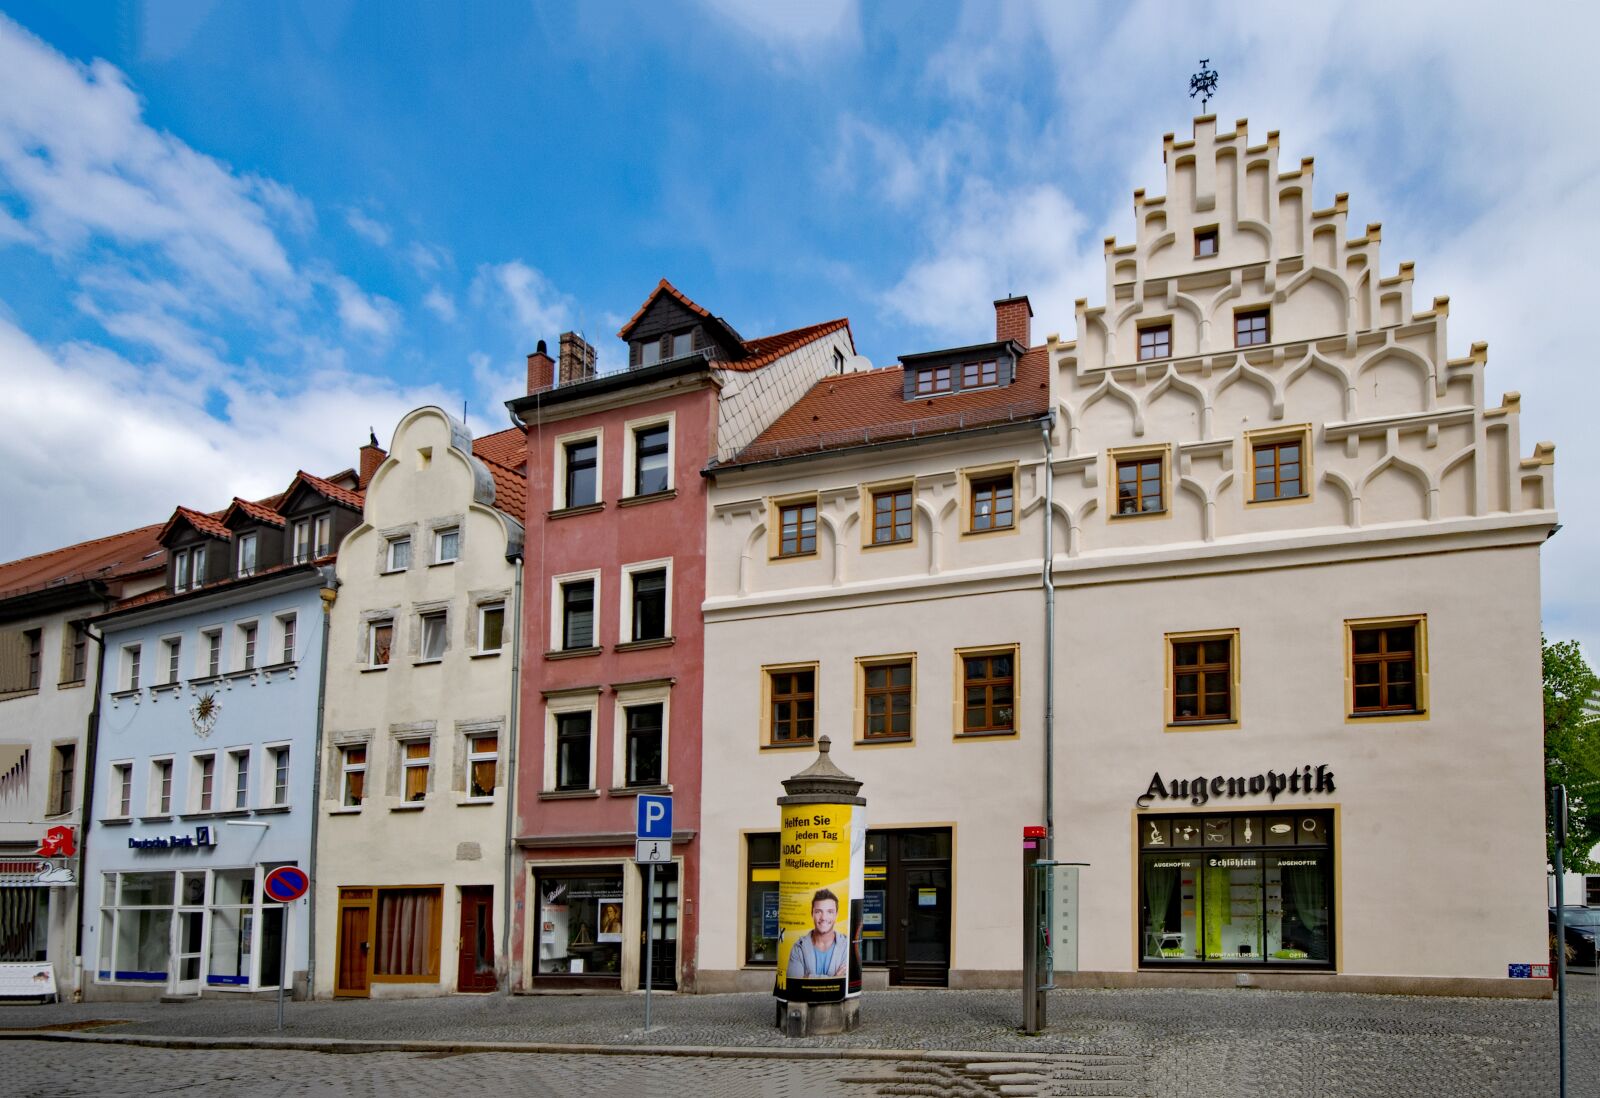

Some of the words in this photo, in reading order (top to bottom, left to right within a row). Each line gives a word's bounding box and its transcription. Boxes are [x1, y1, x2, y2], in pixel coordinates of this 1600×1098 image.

[1137, 764, 1336, 808] Augenoptik
[646, 801, 665, 833] P
[784, 816, 810, 828] Helfen
[813, 815, 831, 826] Sie
[128, 836, 168, 848] Deutsche
[169, 835, 193, 848] Bank
[795, 830, 819, 841] jeden
[822, 830, 838, 840] Tag
[785, 858, 834, 869] Mitgliedern!
